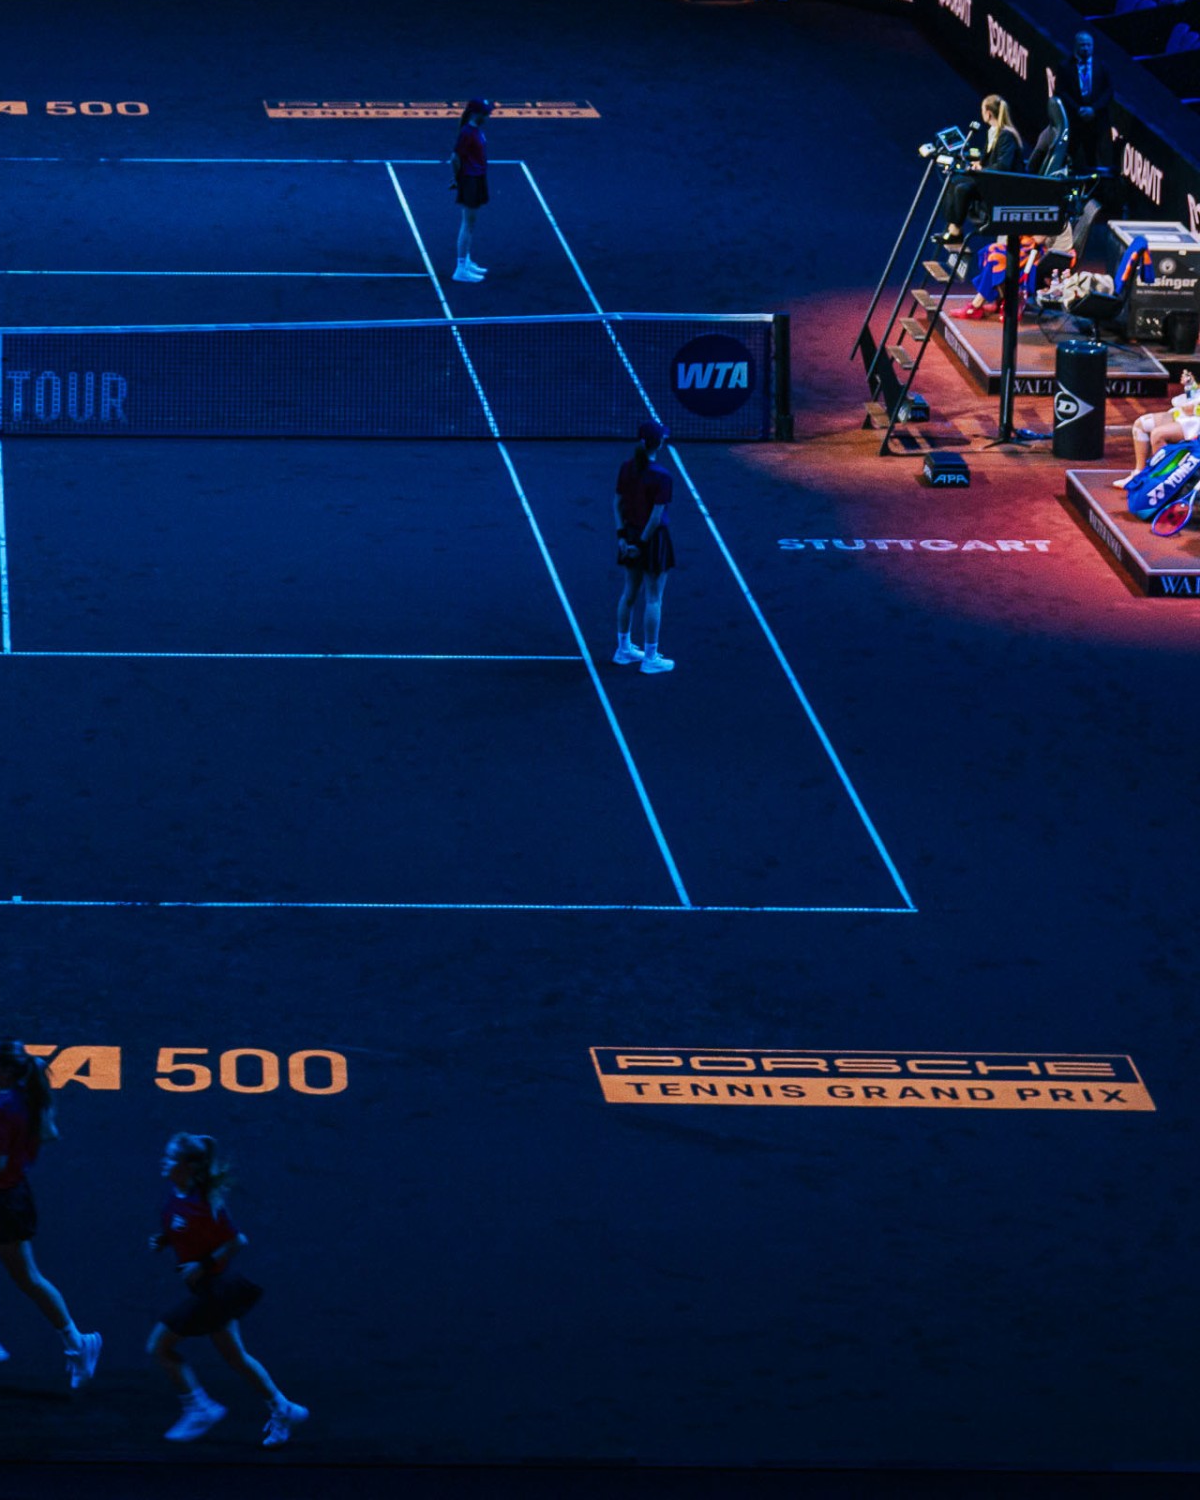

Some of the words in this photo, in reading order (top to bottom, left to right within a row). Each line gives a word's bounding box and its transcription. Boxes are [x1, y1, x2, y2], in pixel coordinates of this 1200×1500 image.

[46, 101, 150, 115] 500
[1122, 142, 1163, 207] DURAVIT
[992, 205, 1060, 222] PIRELLI
[676, 360, 749, 389] WTA
[6, 370, 129, 422] TOUR
[932, 473, 969, 485] APA
[777, 537, 1052, 552] STUTTGART
[153, 1047, 349, 1095] 500
[615, 1054, 1116, 1077] PORSCHE
[625, 1081, 808, 1099] TENNIS
[826, 1085, 997, 1102] GRAND
[1015, 1087, 1129, 1104] PRIX
